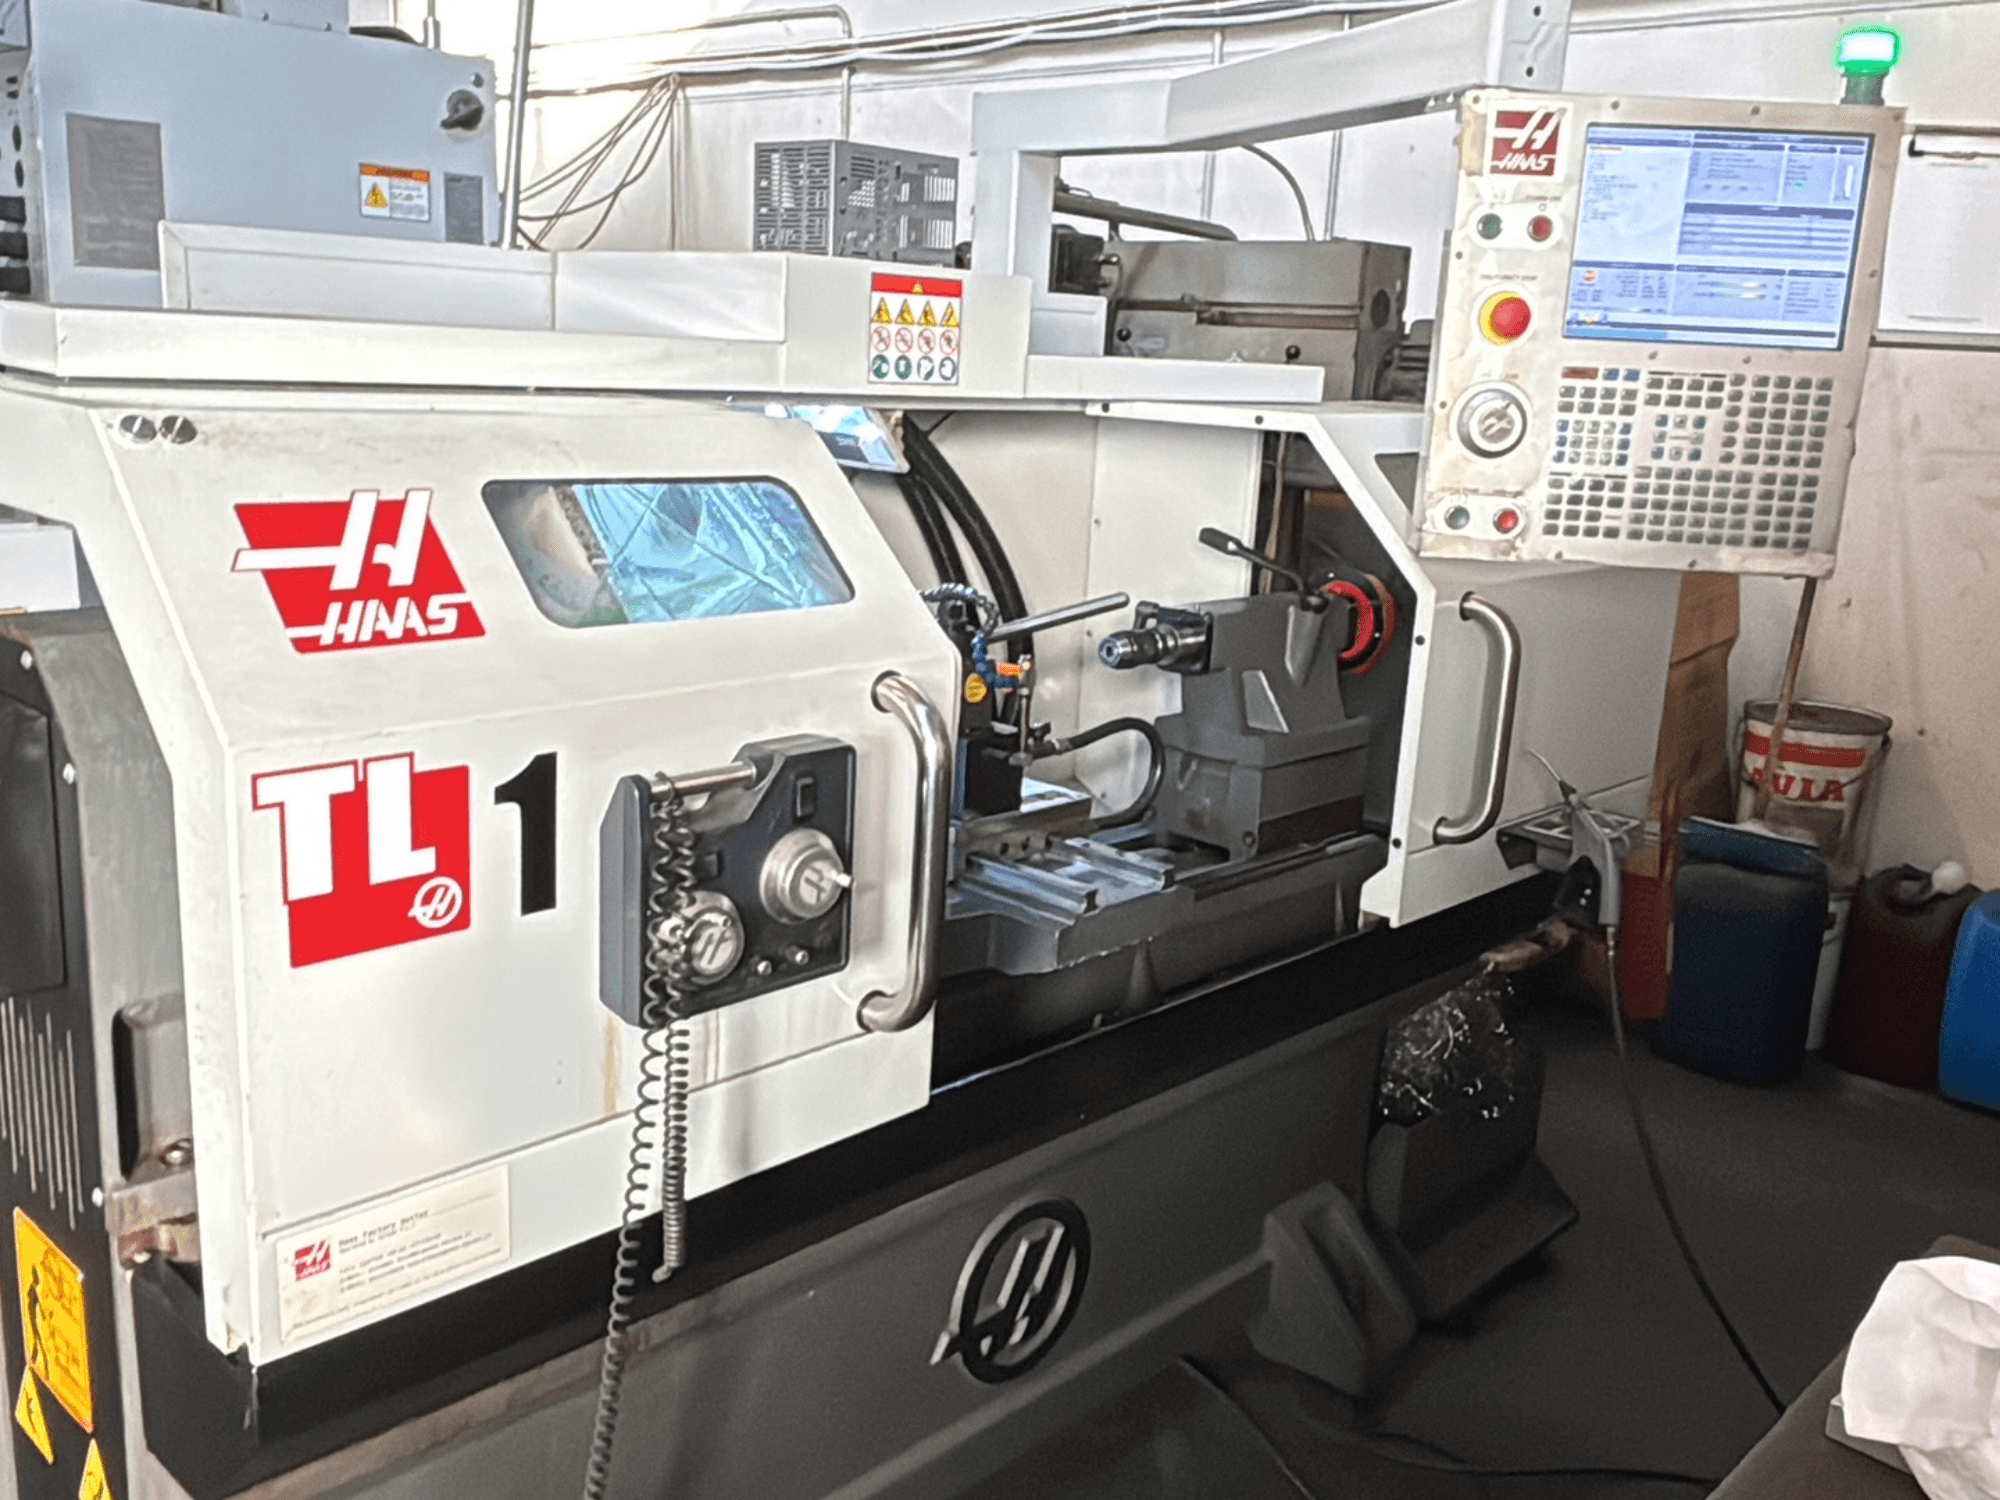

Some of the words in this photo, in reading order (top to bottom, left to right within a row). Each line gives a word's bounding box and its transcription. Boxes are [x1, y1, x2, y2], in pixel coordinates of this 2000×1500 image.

[1491, 153, 1556, 171] HAAS
[284, 593, 473, 646] HAAS
[251, 752, 437, 904] TL
[494, 752, 557, 917] 1
